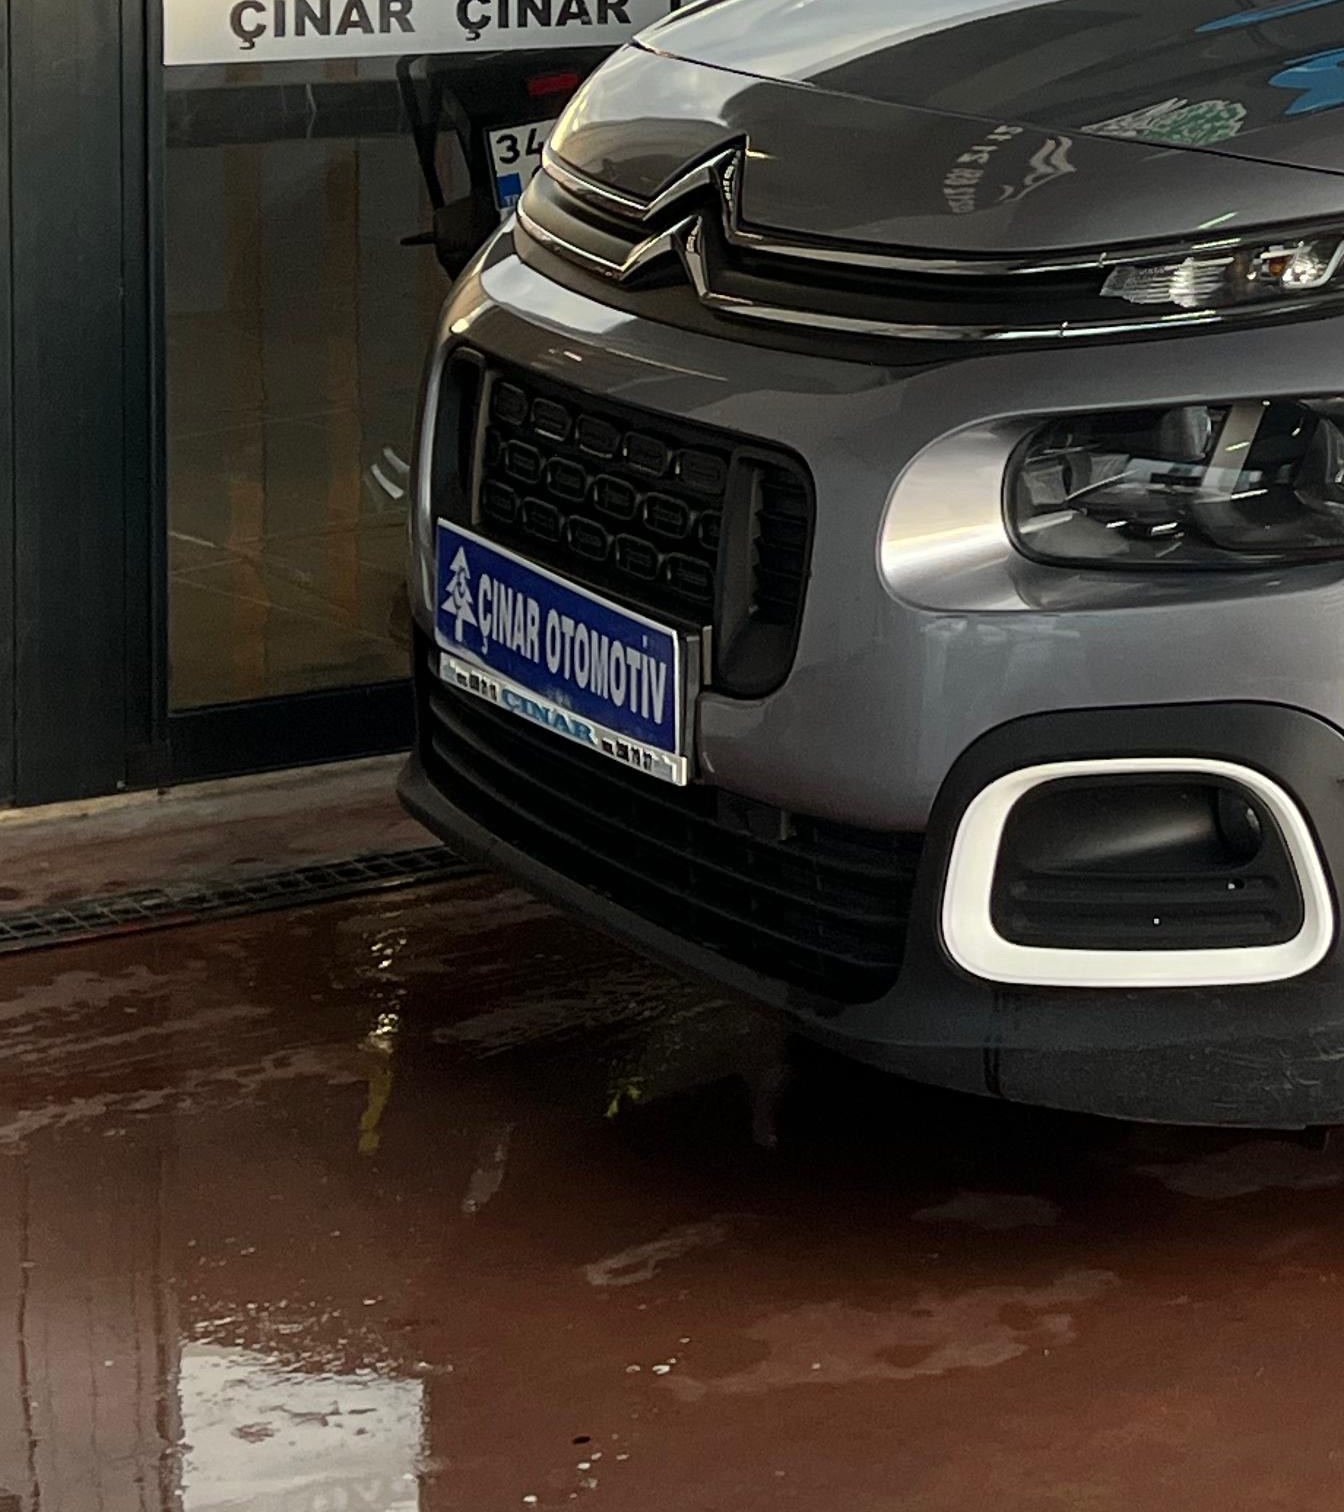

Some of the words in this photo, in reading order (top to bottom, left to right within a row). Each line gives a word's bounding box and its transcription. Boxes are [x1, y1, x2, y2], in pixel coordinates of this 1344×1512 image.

[496, 128, 545, 164] 34
[478, 574, 540, 664] ÇINAR
[546, 608, 667, 725] OTOMOTİV
